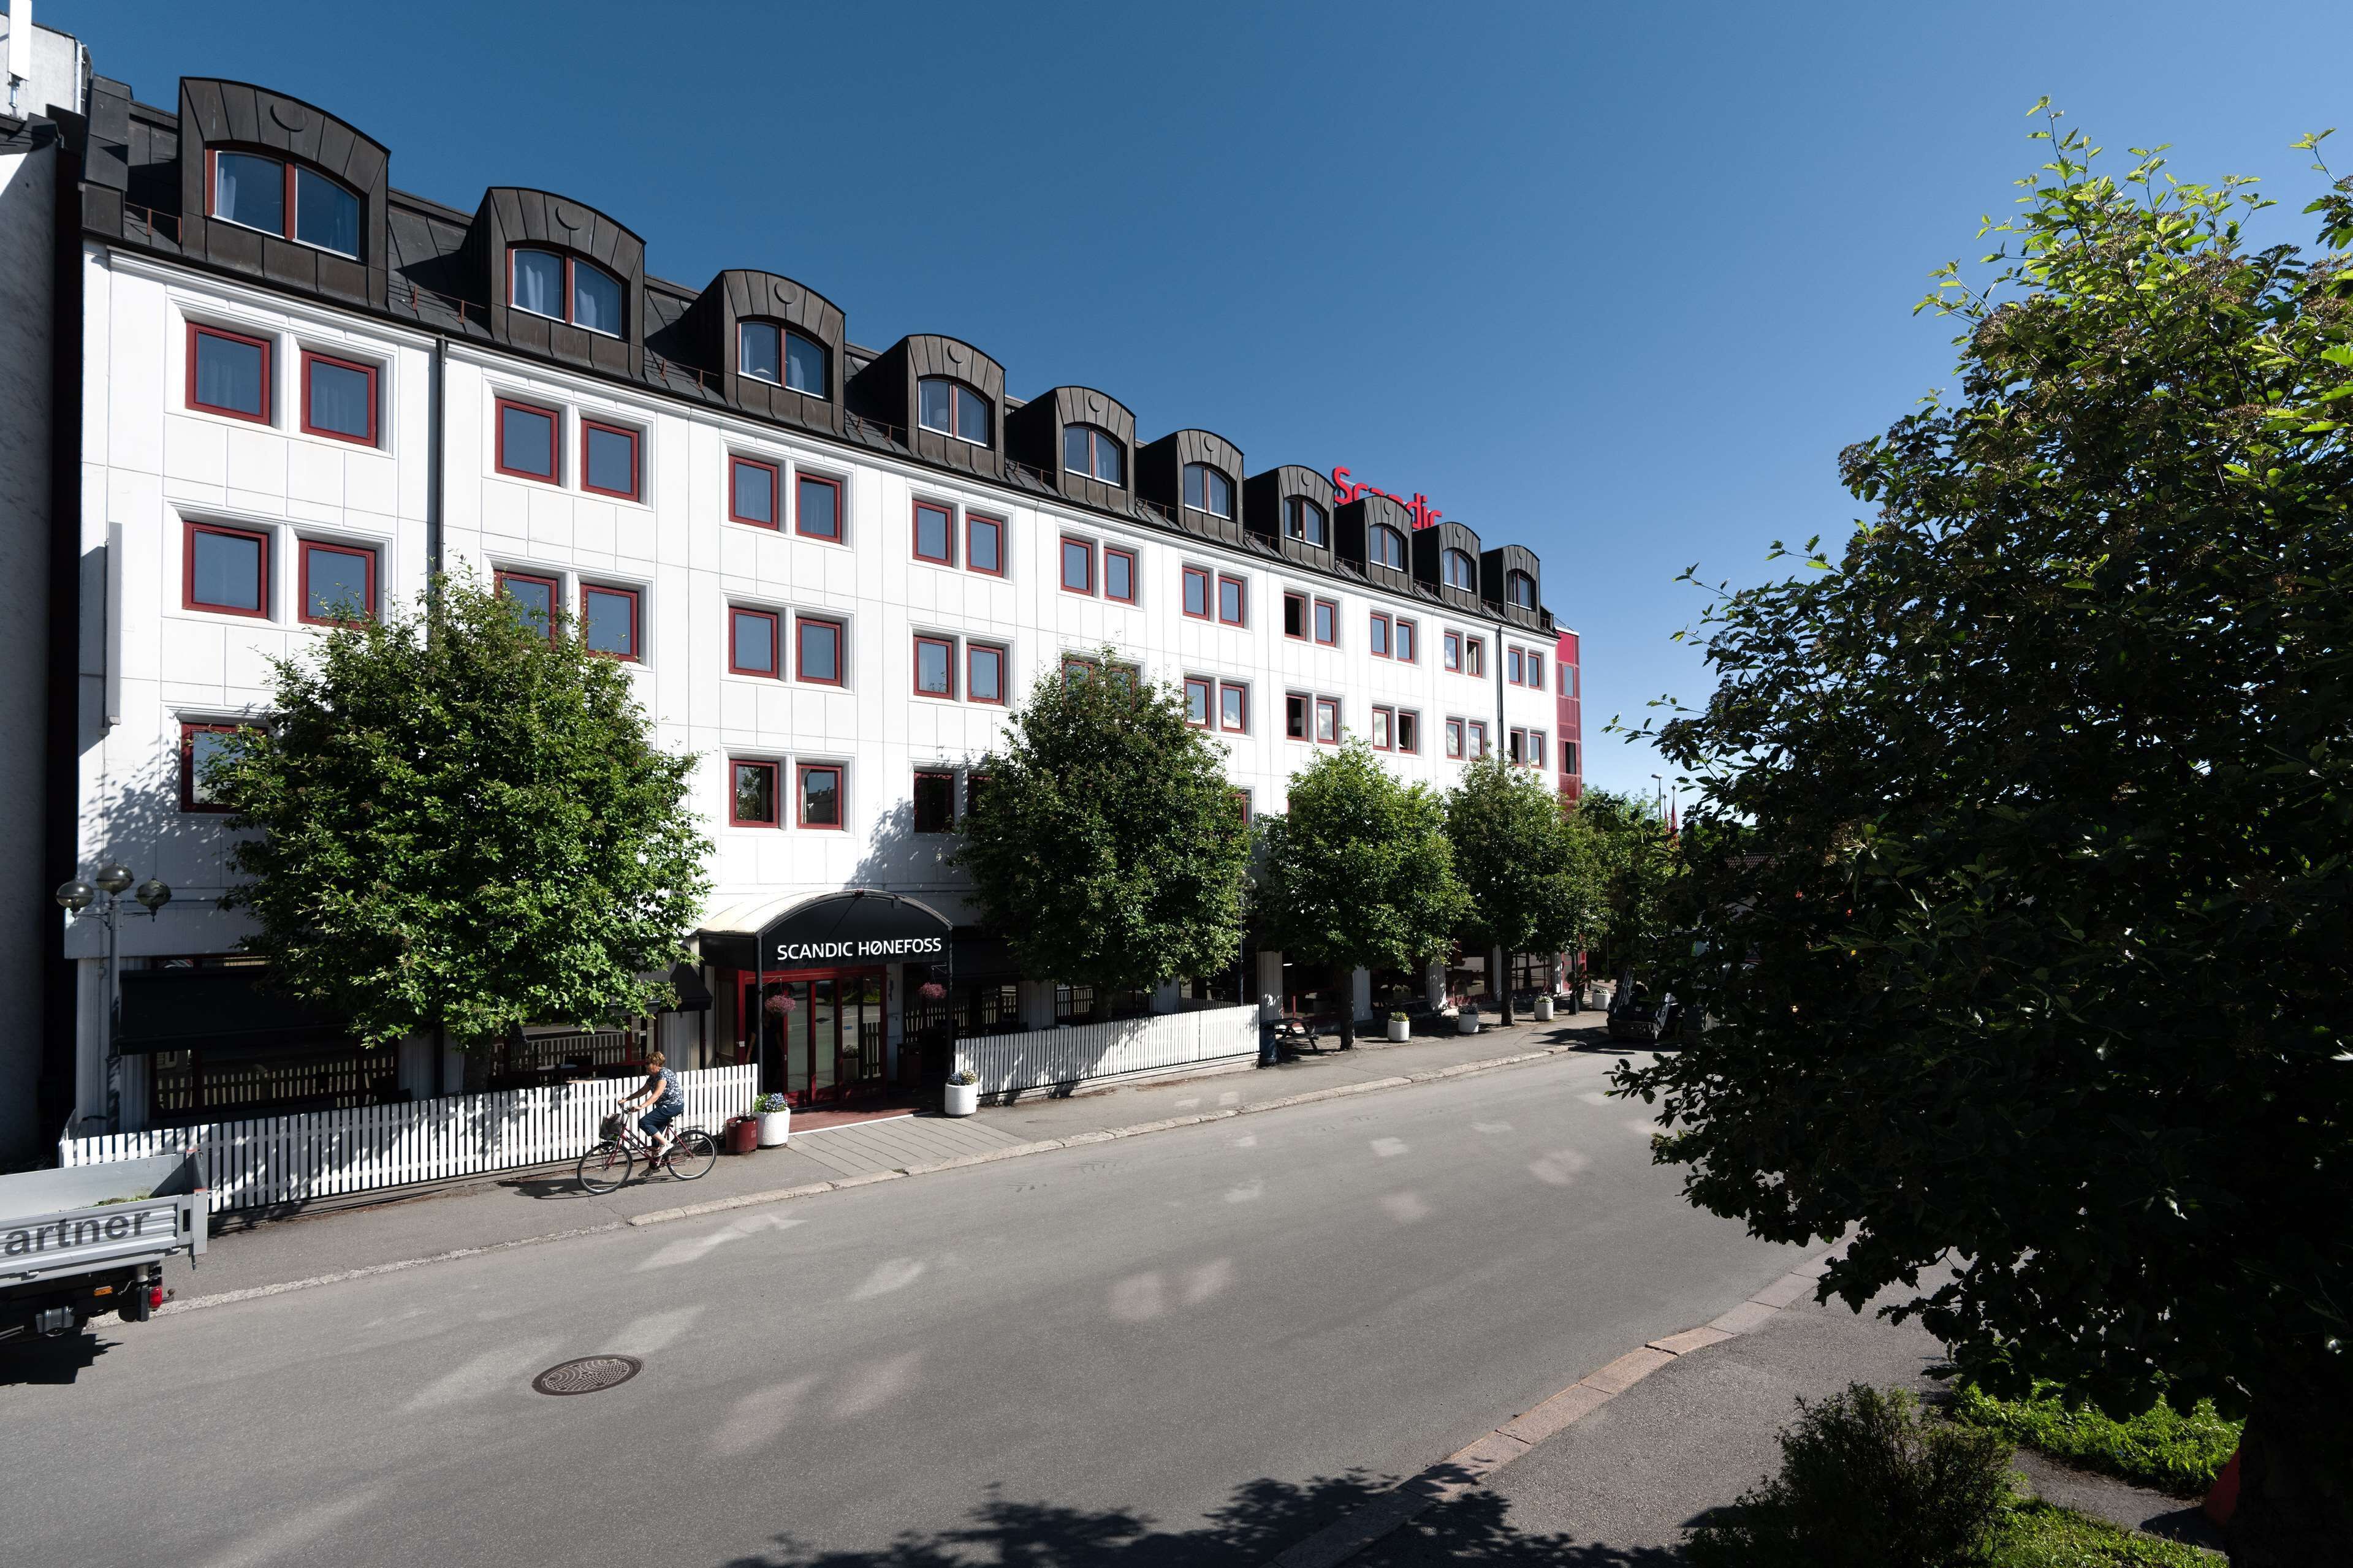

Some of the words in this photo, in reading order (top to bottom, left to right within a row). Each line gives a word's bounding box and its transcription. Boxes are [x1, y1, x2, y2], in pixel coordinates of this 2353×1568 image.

[1332, 466, 1442, 529] Scdic
[777, 942, 853, 960] SCANDIC
[858, 938, 941, 955] HØNEFOSS
